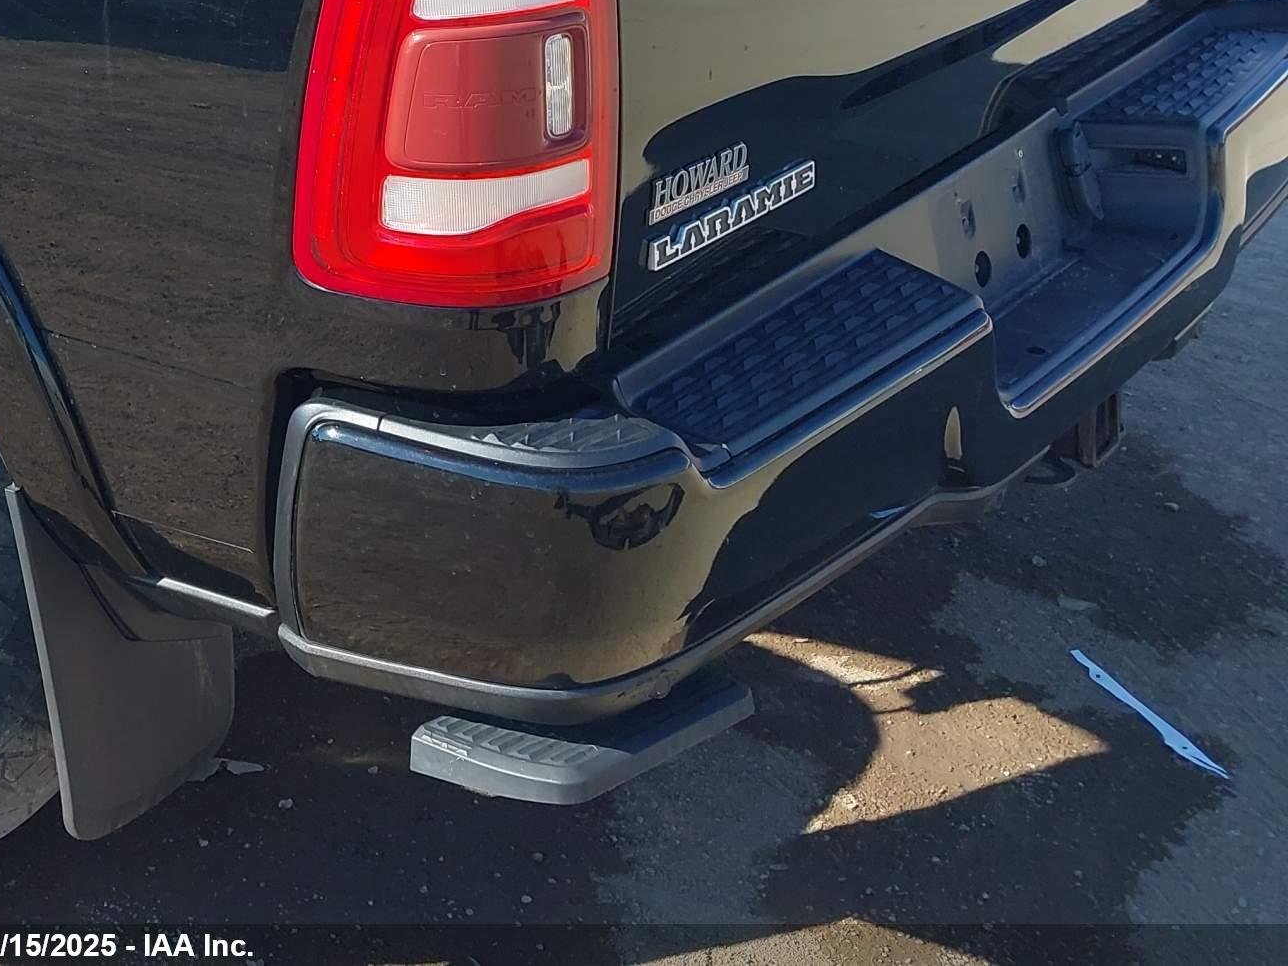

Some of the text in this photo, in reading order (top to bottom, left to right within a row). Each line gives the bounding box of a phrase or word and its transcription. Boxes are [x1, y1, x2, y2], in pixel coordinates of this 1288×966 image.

[422, 87, 537, 109] RAM
[654, 142, 748, 209] HOWARD
[654, 171, 744, 221] DODGE CHRYSLER JEEP
[650, 161, 814, 271] LARAMIE
